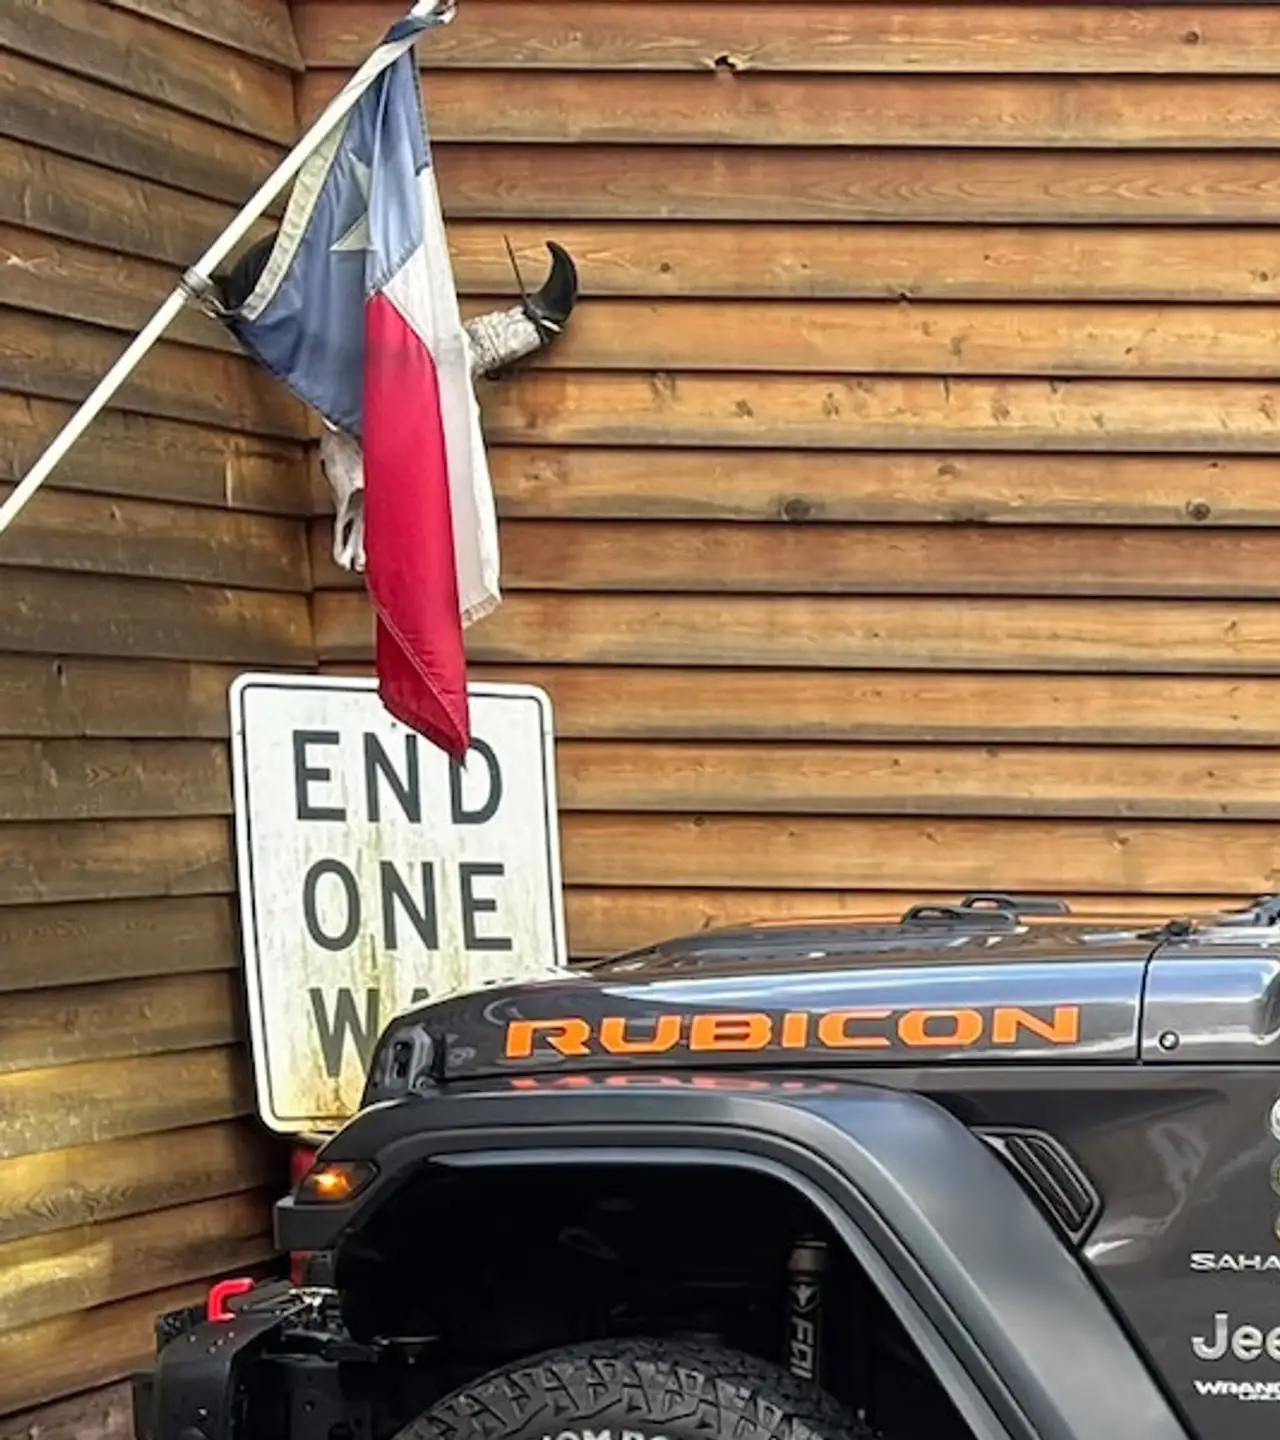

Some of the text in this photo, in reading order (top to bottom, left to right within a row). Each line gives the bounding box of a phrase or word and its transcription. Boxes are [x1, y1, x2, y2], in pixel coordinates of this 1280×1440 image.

[292, 728, 504, 825] END
[302, 858, 513, 953] ONE
[504, 1006, 1081, 1059] RUBICON
